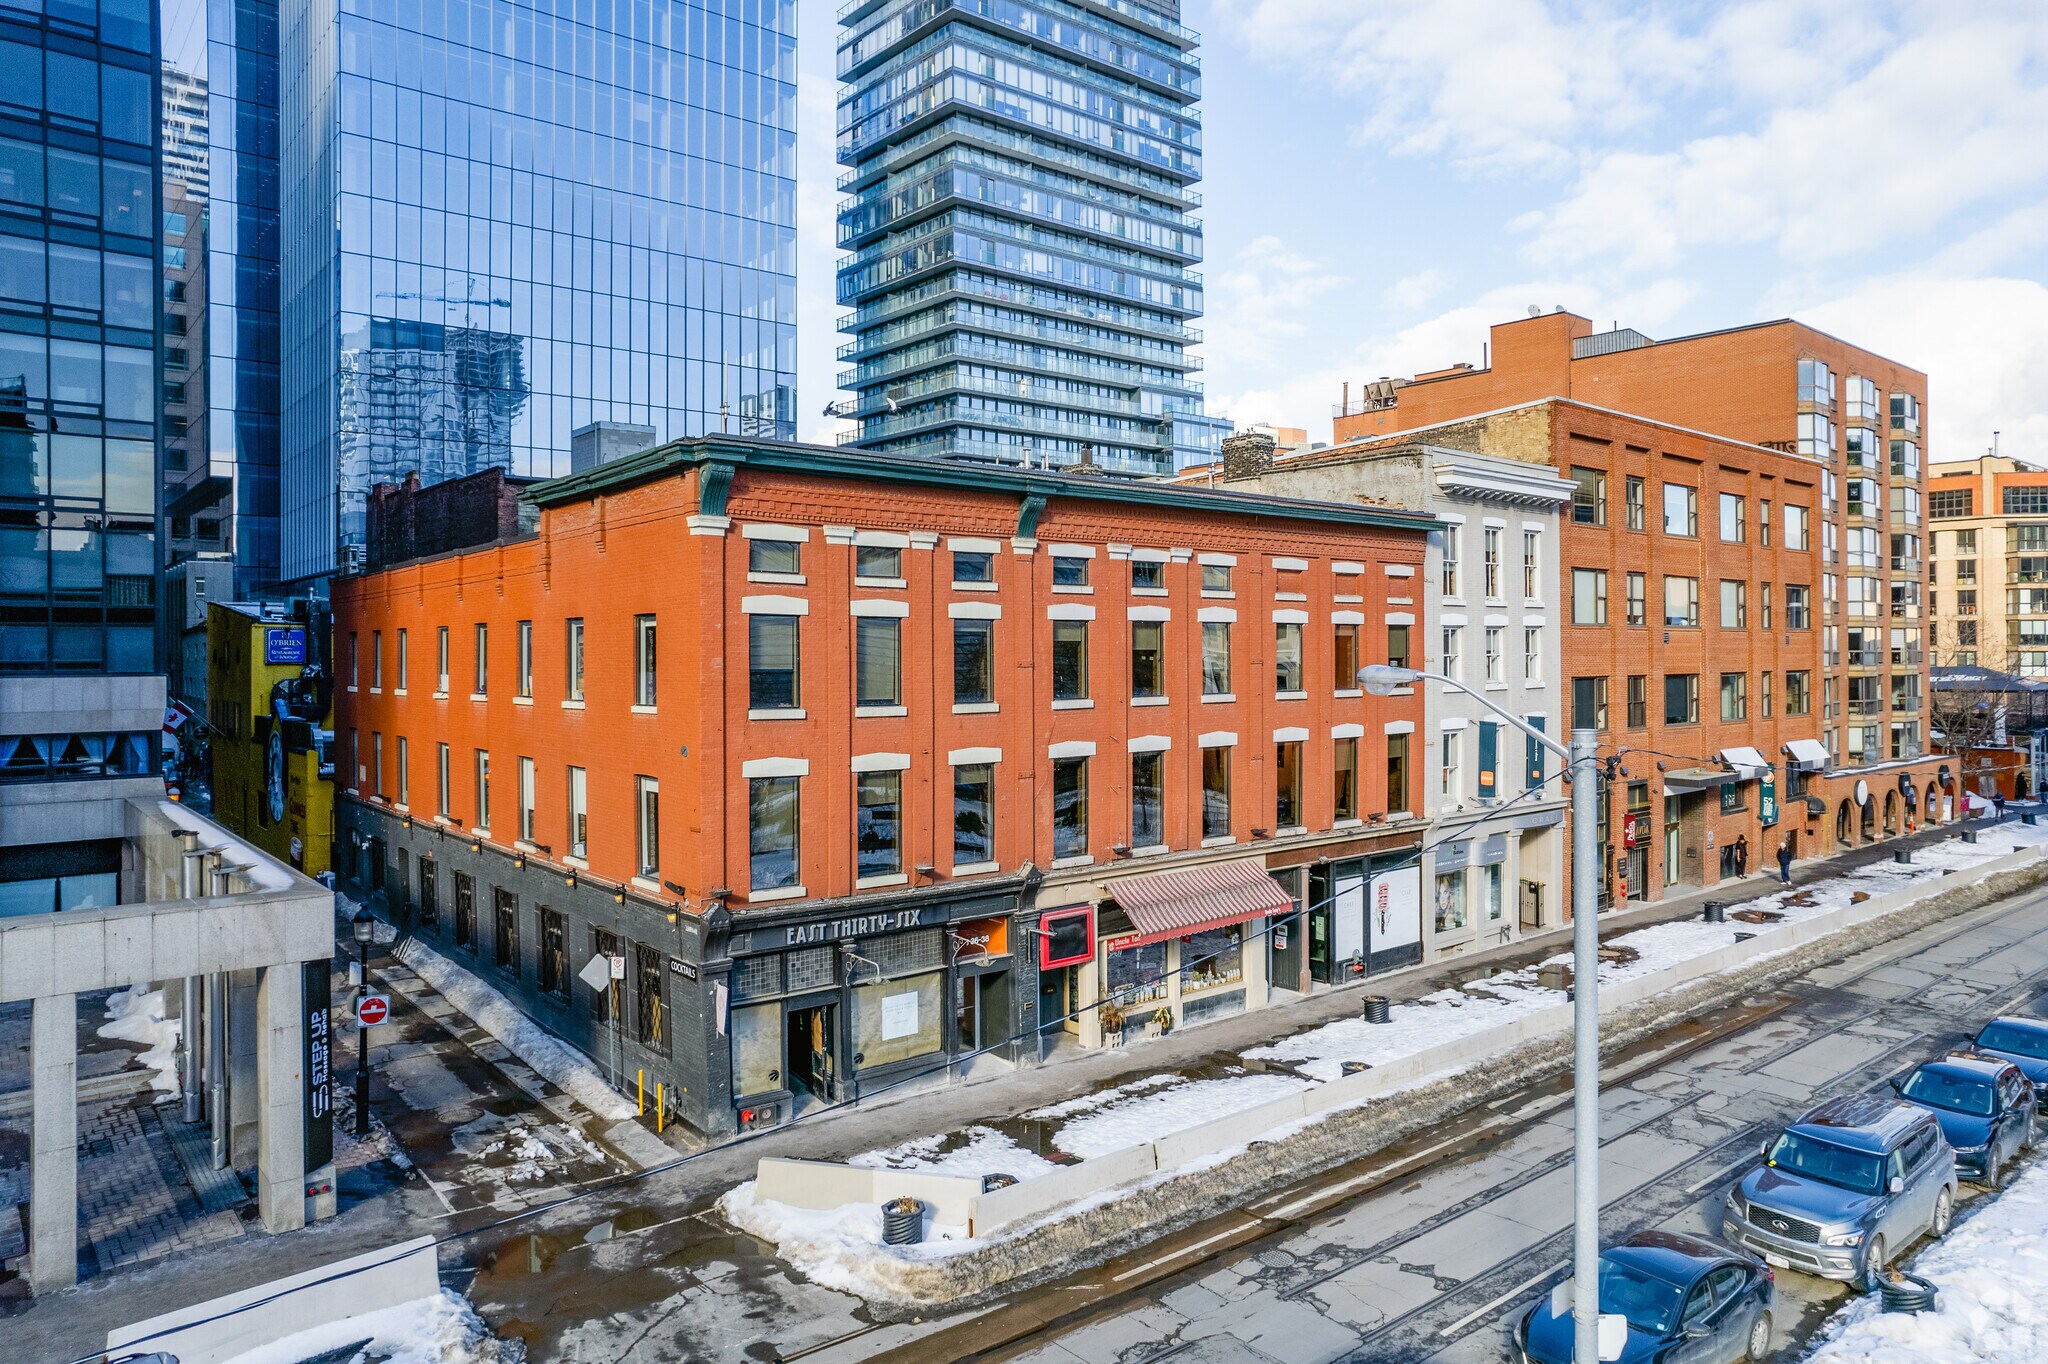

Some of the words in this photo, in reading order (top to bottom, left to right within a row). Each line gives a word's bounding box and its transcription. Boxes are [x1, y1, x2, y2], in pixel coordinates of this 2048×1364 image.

[1763, 797, 1773, 805] 52
[786, 923, 827, 945] EAST
[831, 909, 921, 938] THIRTY-SIX
[670, 961, 696, 979] COCKTAILS
[311, 1011, 323, 1038] UP
[311, 1040, 323, 1086] STEP
